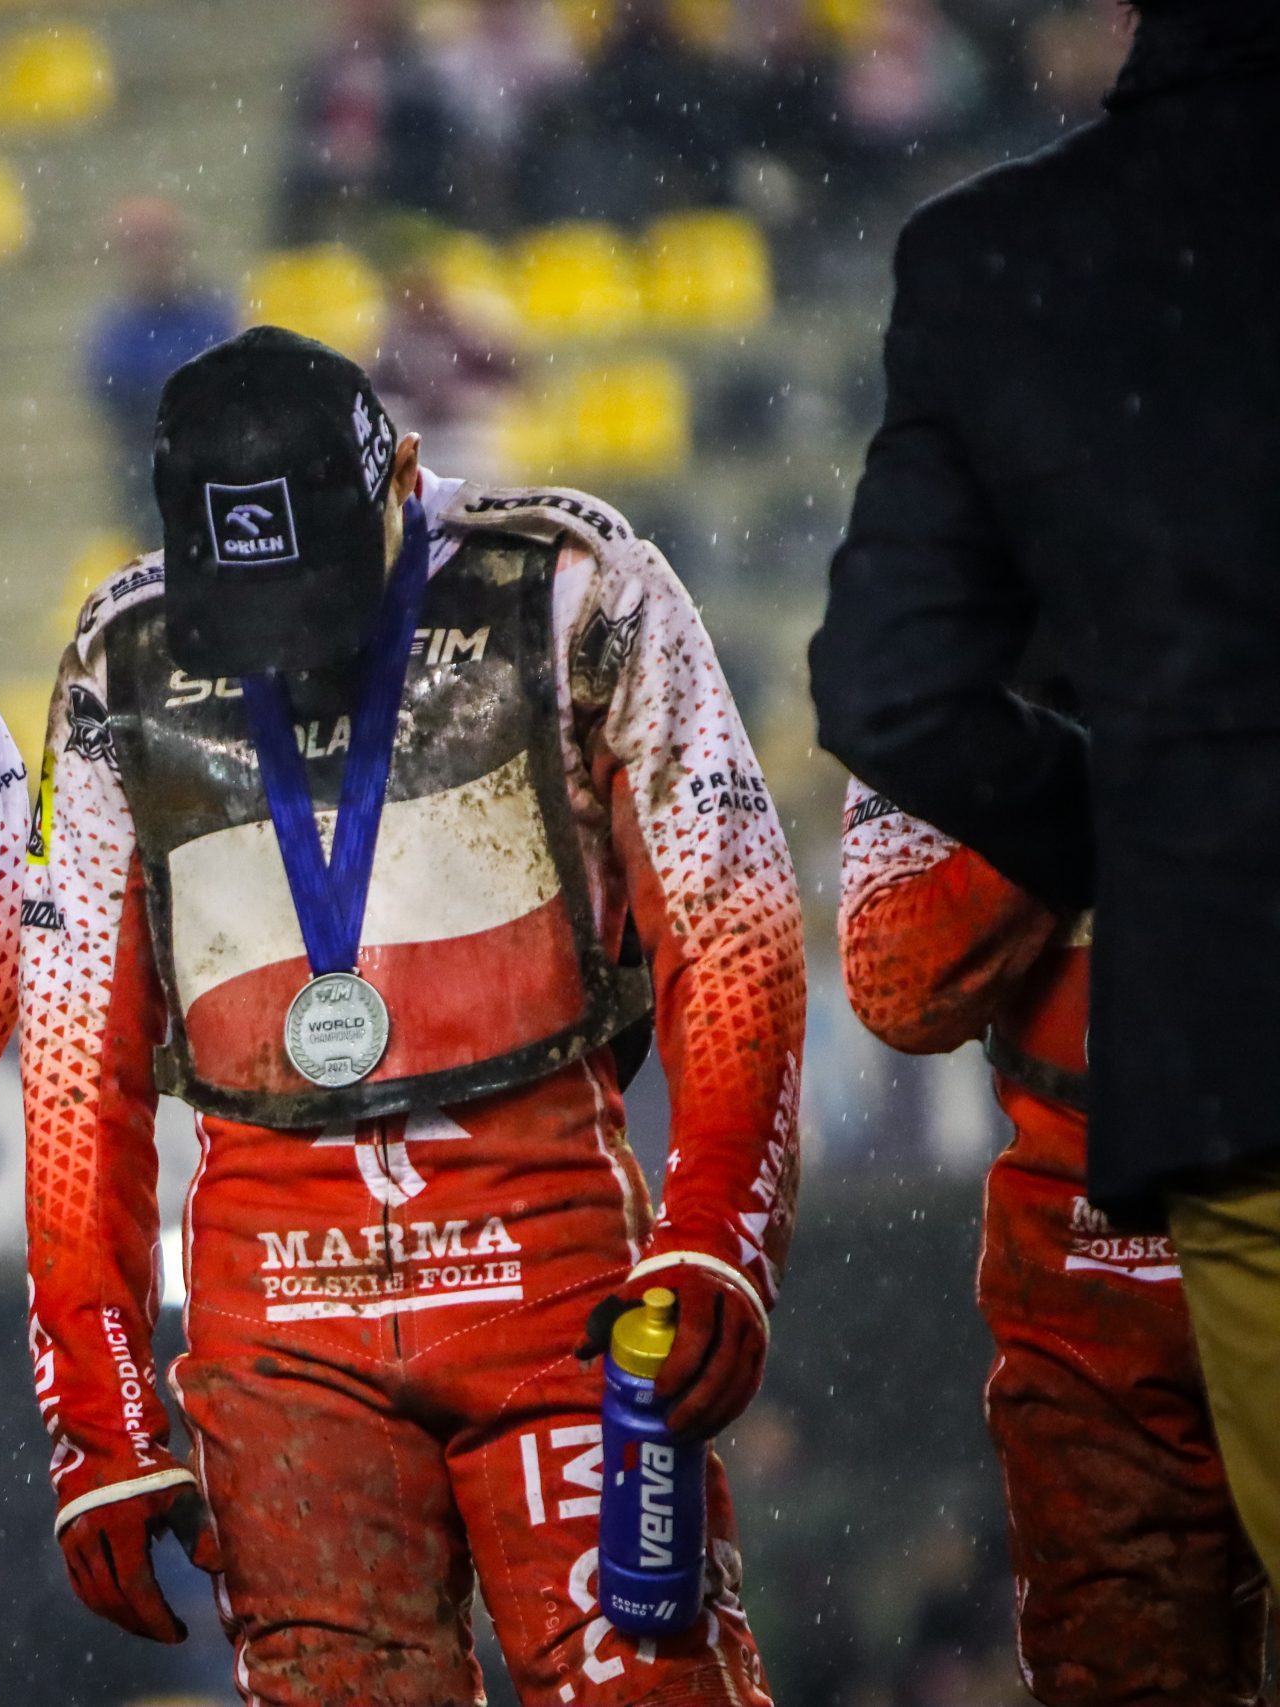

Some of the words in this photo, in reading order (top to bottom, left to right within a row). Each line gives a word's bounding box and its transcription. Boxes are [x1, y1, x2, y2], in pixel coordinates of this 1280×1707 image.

[223, 535, 285, 555] ORLEN
[408, 625, 491, 667] FIM
[308, 1017, 365, 1033] WORLD
[256, 1215, 522, 1270] MARMA
[1072, 1236, 1179, 1260] POLSK
[261, 1271, 405, 1299] POLSKIE
[418, 1260, 523, 1289] FOLIE
[639, 1441, 675, 1568] verva
[611, 1594, 656, 1611] PROMET
[612, 1601, 647, 1617] CARGO
